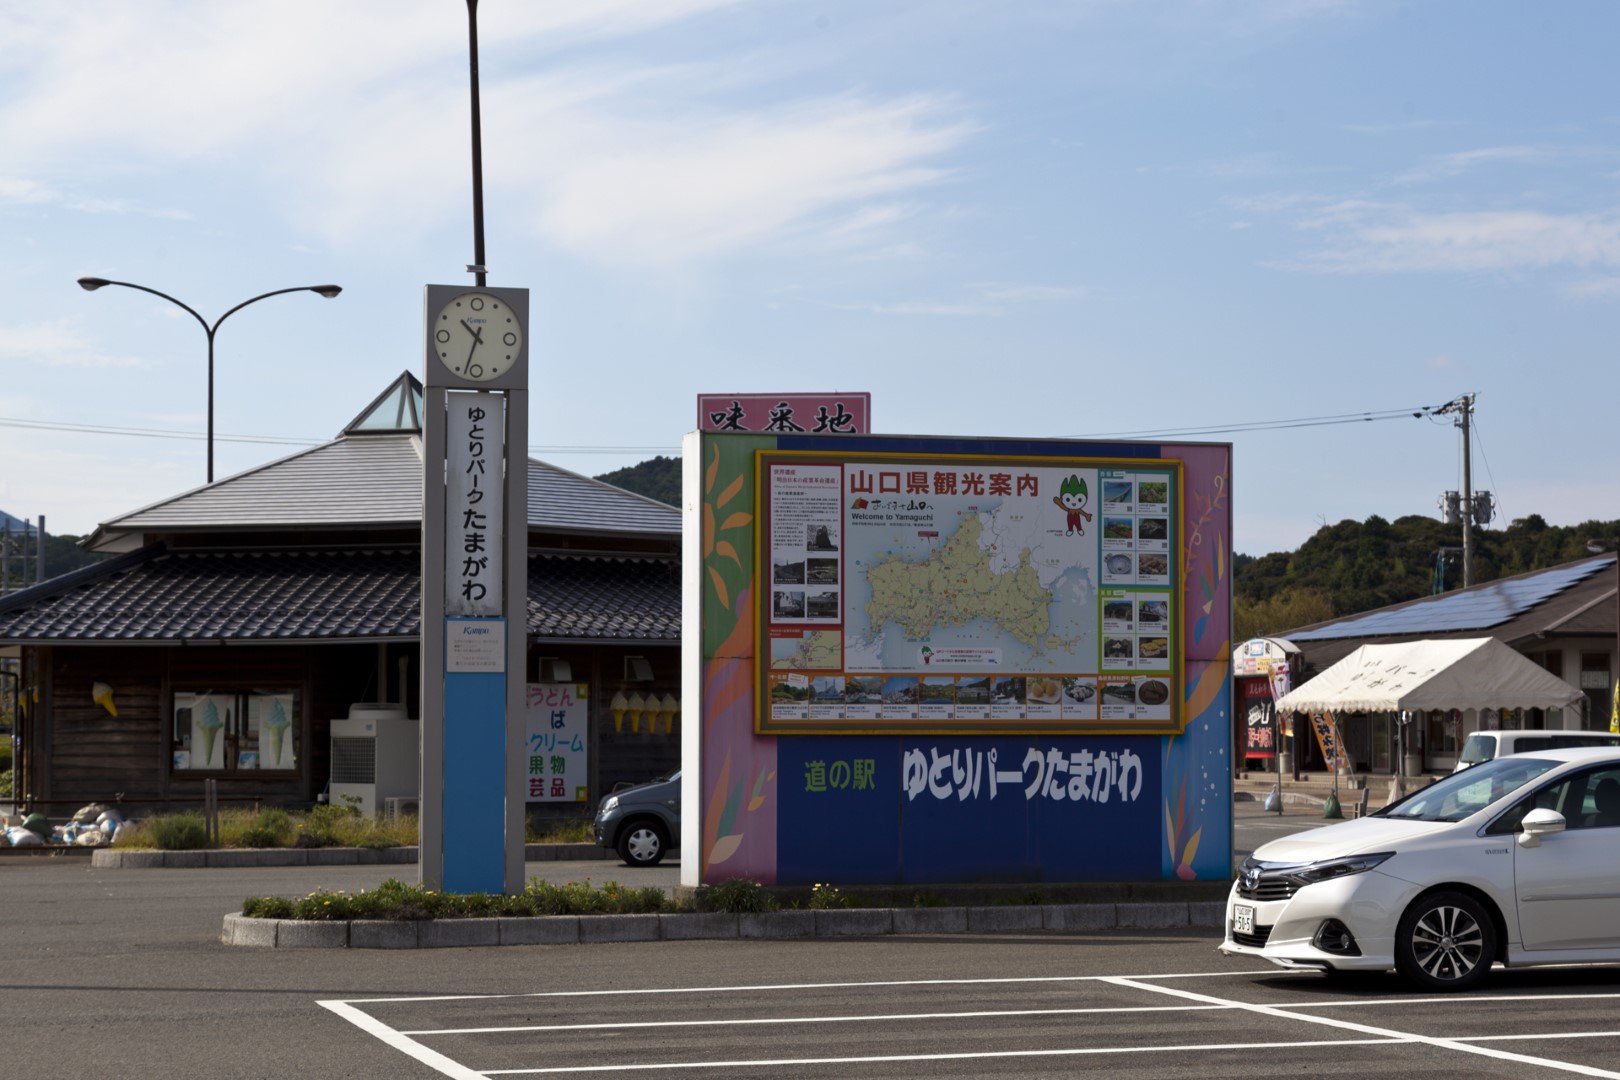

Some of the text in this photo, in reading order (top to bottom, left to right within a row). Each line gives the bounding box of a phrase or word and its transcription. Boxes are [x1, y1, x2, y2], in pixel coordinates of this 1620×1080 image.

[850, 470, 1039, 497] 山口県観光案内
[462, 406, 488, 601] ゆとりパークたまがわ
[895, 514, 934, 522] Yamaguchi
[526, 687, 574, 707] うどん
[525, 733, 584, 752] クリーム
[804, 758, 875, 792] 道の駅
[902, 746, 1143, 803] ゆとりパークたまがわ
